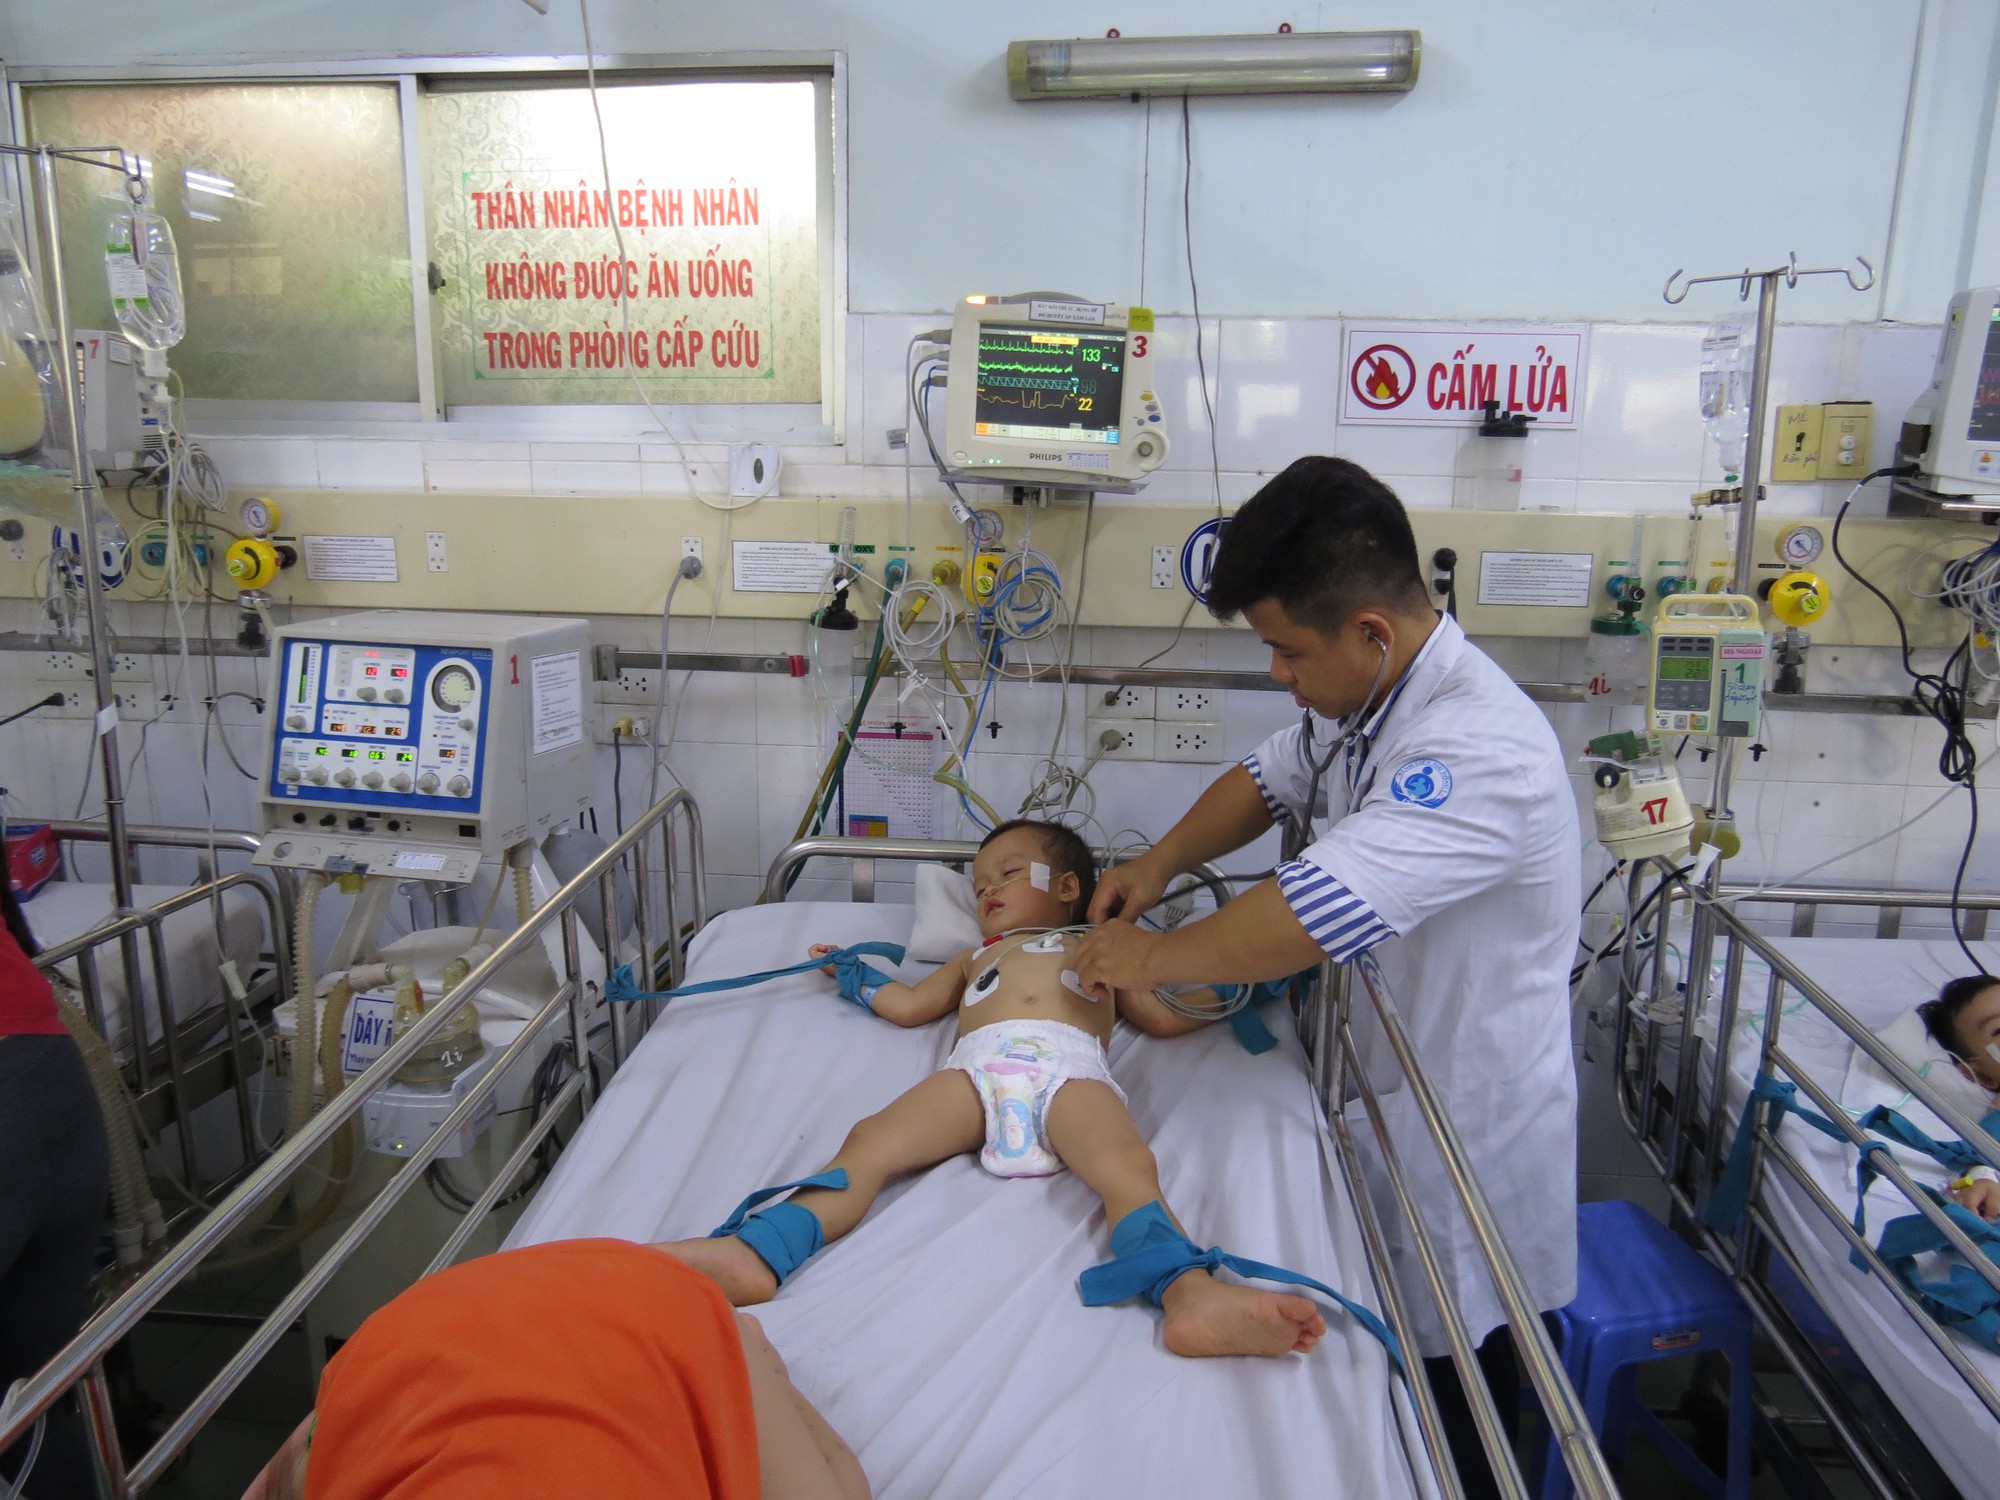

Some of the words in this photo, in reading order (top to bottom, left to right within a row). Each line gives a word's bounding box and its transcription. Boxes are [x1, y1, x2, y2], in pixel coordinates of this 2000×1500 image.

[471, 181, 535, 230] THÂN
[545, 180, 609, 228] NHÂN
[618, 179, 683, 236] BỆNH
[693, 177, 759, 226] NHÂN
[485, 252, 567, 300] KHÔNG
[574, 251, 638, 306] ĐƯỢC
[647, 252, 679, 298] ĂN
[688, 244, 753, 298] UỐNG
[88, 339, 100, 359] 7
[484, 331, 562, 369] TRONG
[570, 321, 649, 369] PHÒNG
[656, 315, 703, 368] CẤP
[711, 320, 759, 369] CỨU
[1131, 335, 1148, 358] 3
[1081, 348, 1101, 362] 133
[1427, 344, 1498, 411] CẤM
[1507, 345, 1568, 413] LỬA
[1077, 397, 1092, 411] 22
[1029, 452, 1062, 462] PHILIPS
[510, 654, 520, 685] 1
[1685, 668, 1701, 679] 22
[1734, 663, 1746, 684] 1
[1641, 797, 1668, 825] 17
[353, 1010, 384, 1045] DÂY
